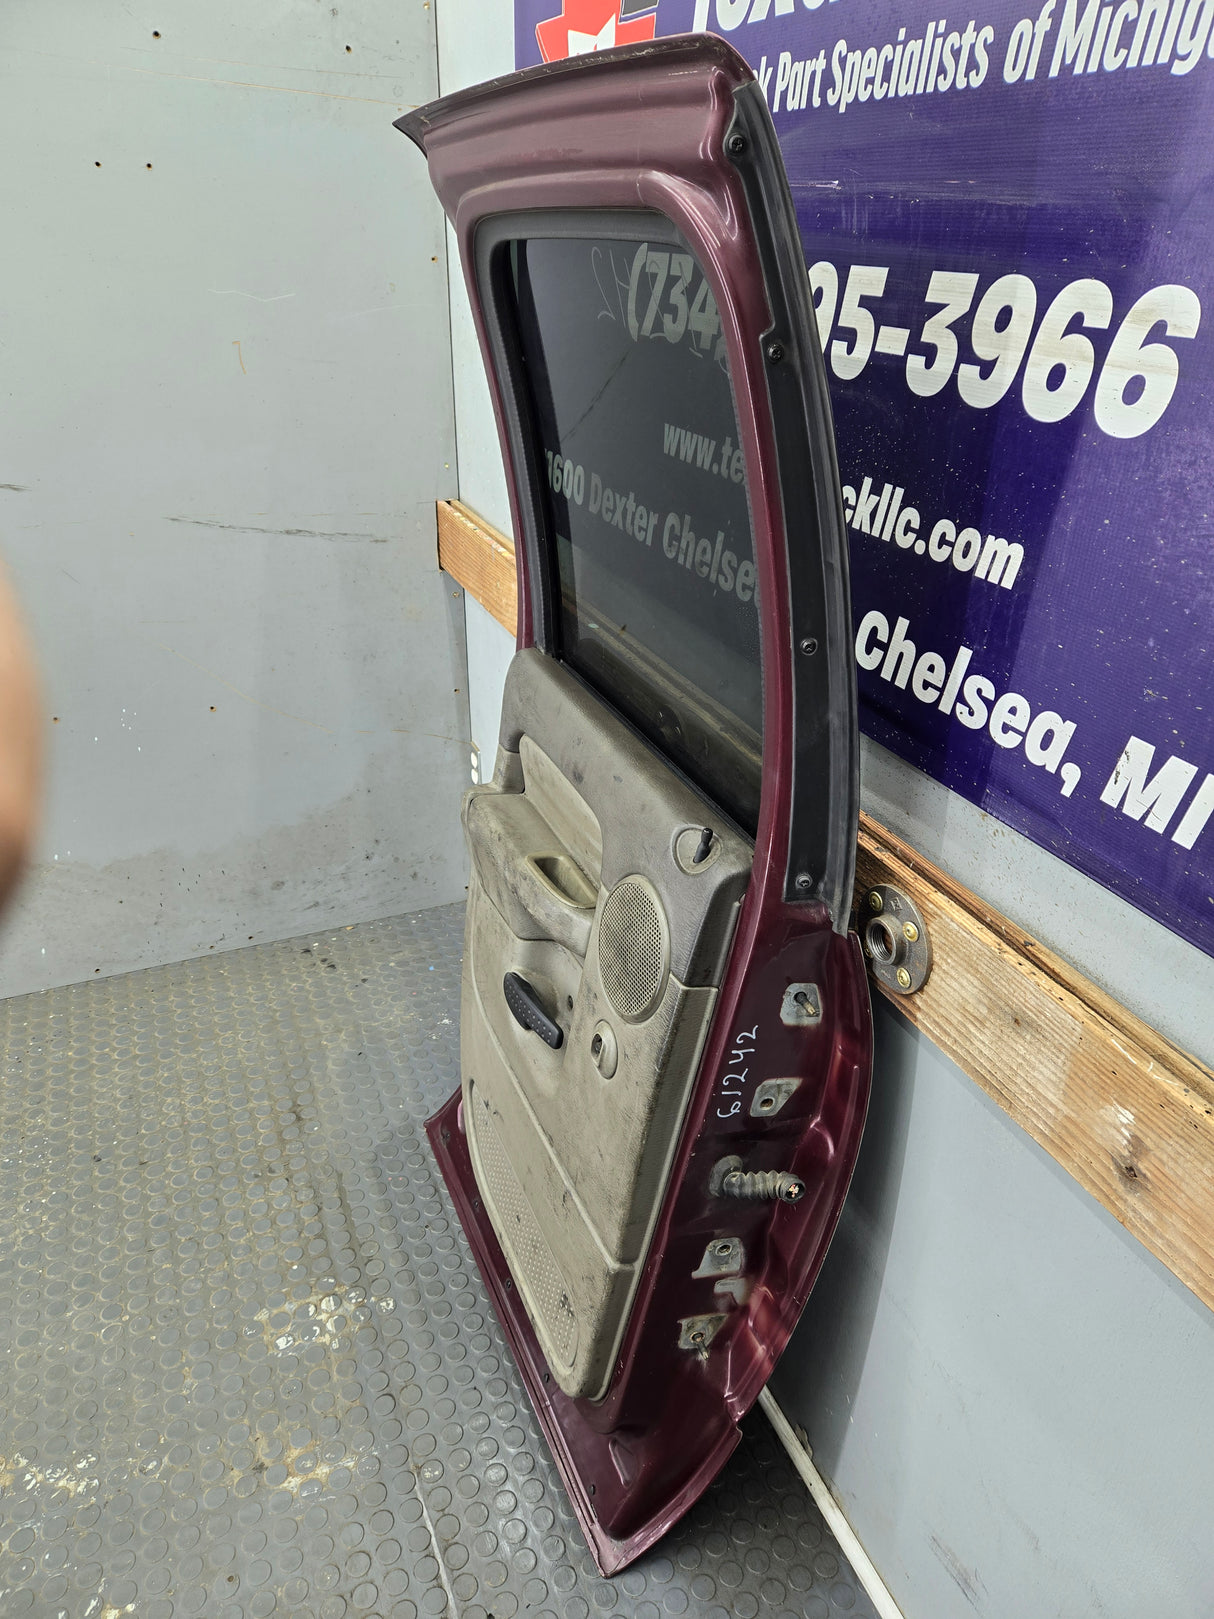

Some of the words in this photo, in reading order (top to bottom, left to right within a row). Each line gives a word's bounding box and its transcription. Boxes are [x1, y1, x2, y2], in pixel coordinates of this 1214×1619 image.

[772, 49, 827, 113] Part
[826, 19, 995, 114] Specialists
[1002, 0, 1056, 84] of
[627, 242, 729, 361] (734
[663, 422, 746, 485] www.te
[545, 448, 586, 506] 1600
[588, 471, 660, 547] Dexter
[662, 511, 760, 609] Chelse
[854, 609, 1082, 799] Chelsea,
[1099, 734, 1214, 851] MI
[716, 1024, 759, 1118] 61242
